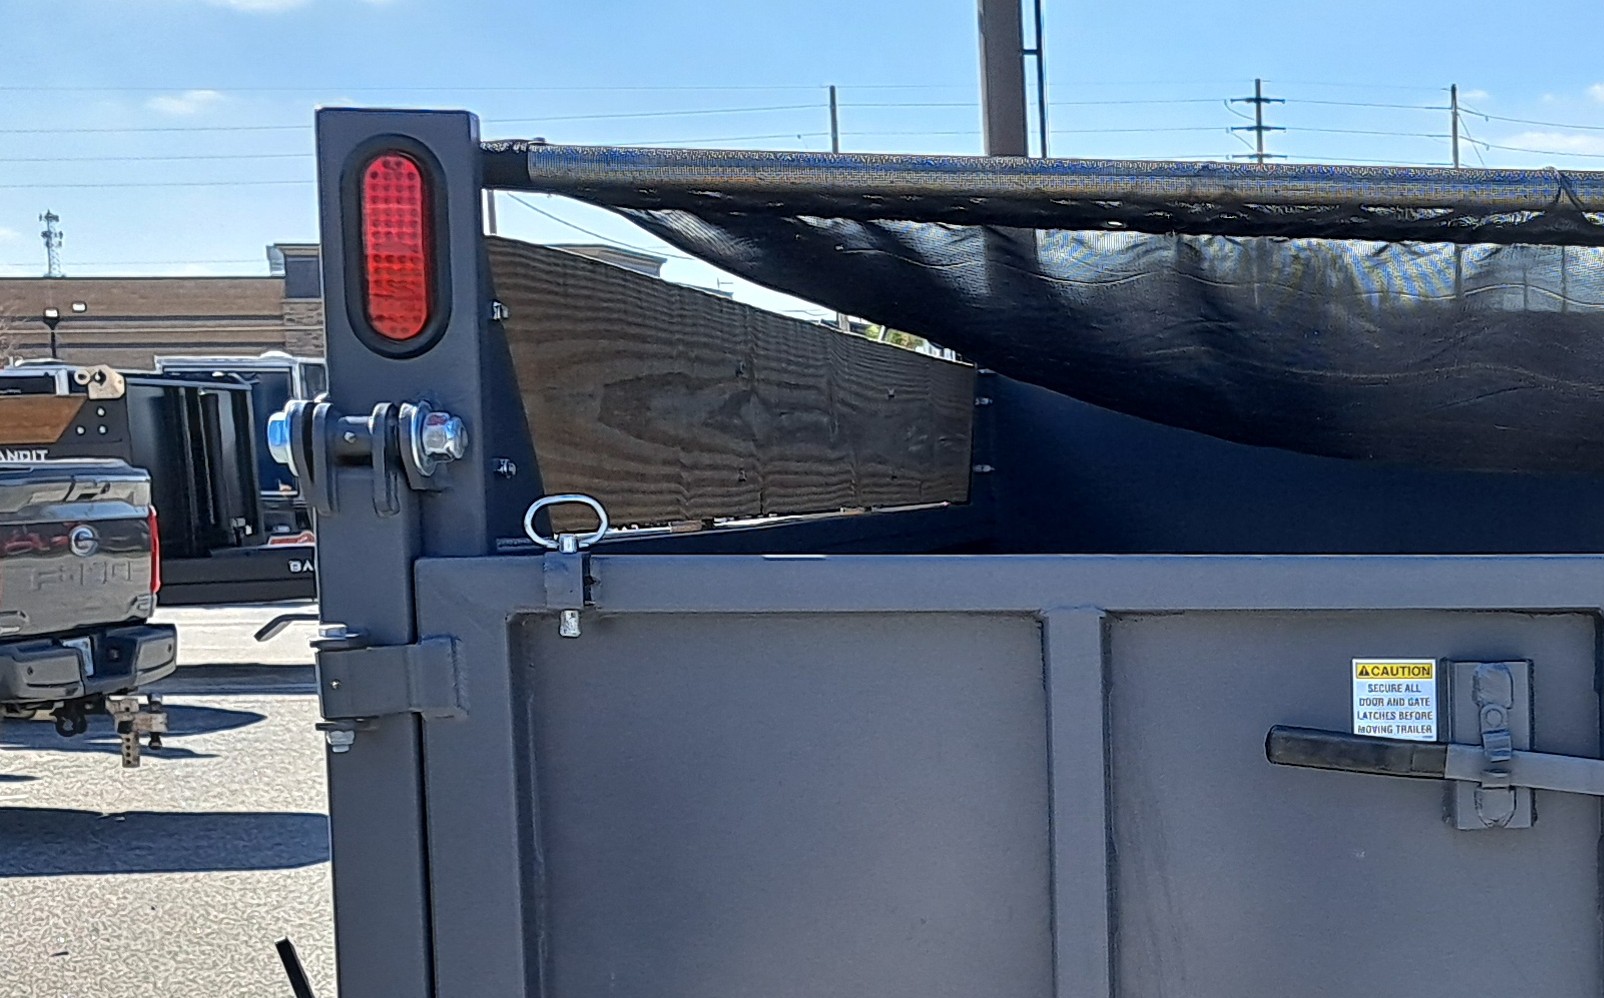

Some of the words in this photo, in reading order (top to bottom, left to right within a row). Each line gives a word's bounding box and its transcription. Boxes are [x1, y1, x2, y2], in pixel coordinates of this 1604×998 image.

[0, 448, 48, 462] ANDIT
[1371, 666, 1430, 676] CAUTION
[1368, 683, 1402, 692] SECURE
[1404, 684, 1422, 692] ALL
[1359, 697, 1384, 706] DOOR
[1387, 697, 1405, 706] AND
[1407, 697, 1430, 706] GATE
[1357, 711, 1396, 720] LATCHES
[1399, 711, 1432, 720] BEFORE
[1358, 725, 1393, 734] MOVING
[1396, 725, 1432, 734] TRAILER
